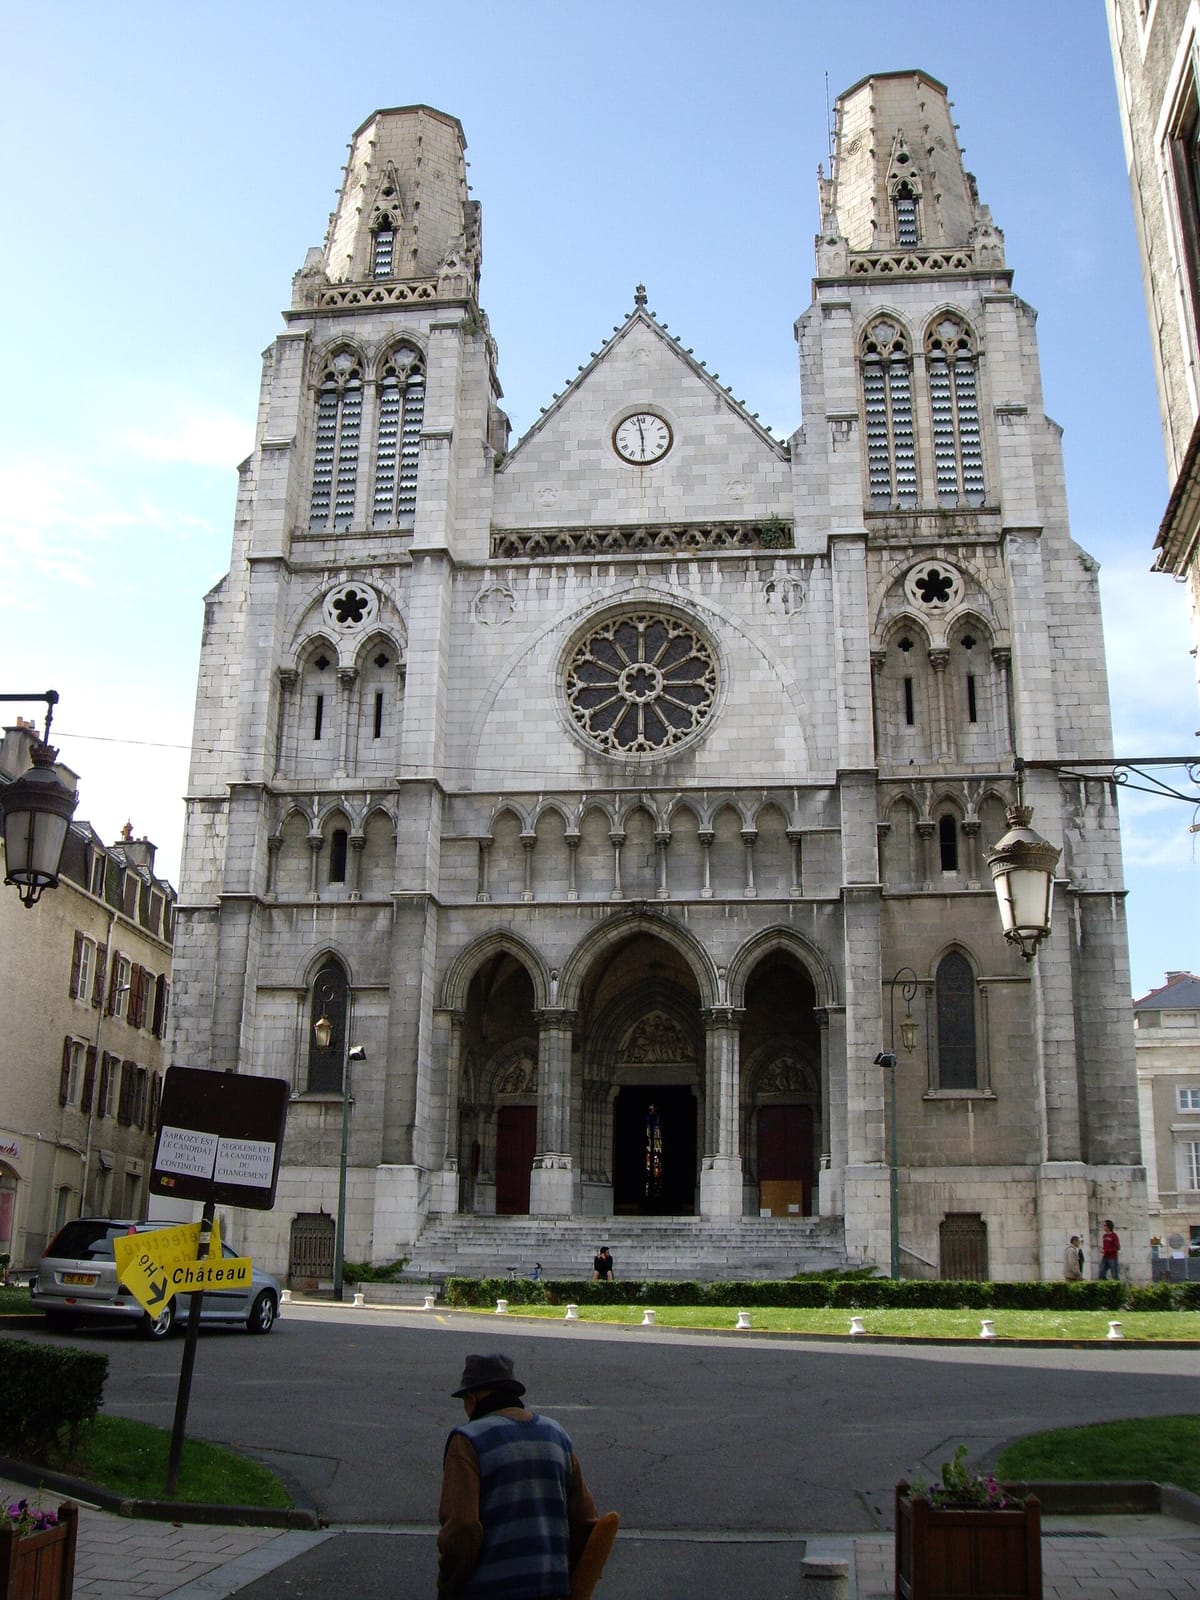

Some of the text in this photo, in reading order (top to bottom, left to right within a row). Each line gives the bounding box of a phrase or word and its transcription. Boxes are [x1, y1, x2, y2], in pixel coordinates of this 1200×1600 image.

[163, 1131, 213, 1146] SARKOZY EST
[173, 1142, 212, 1155] CANDIDAT
[186, 1154, 196, 1162] LA
[219, 1151, 270, 1162] LA CANDIDATE
[239, 1161, 248, 1169] DU
[217, 1168, 268, 1180] CHANGEMENT
[172, 1266, 246, 1284] Château
